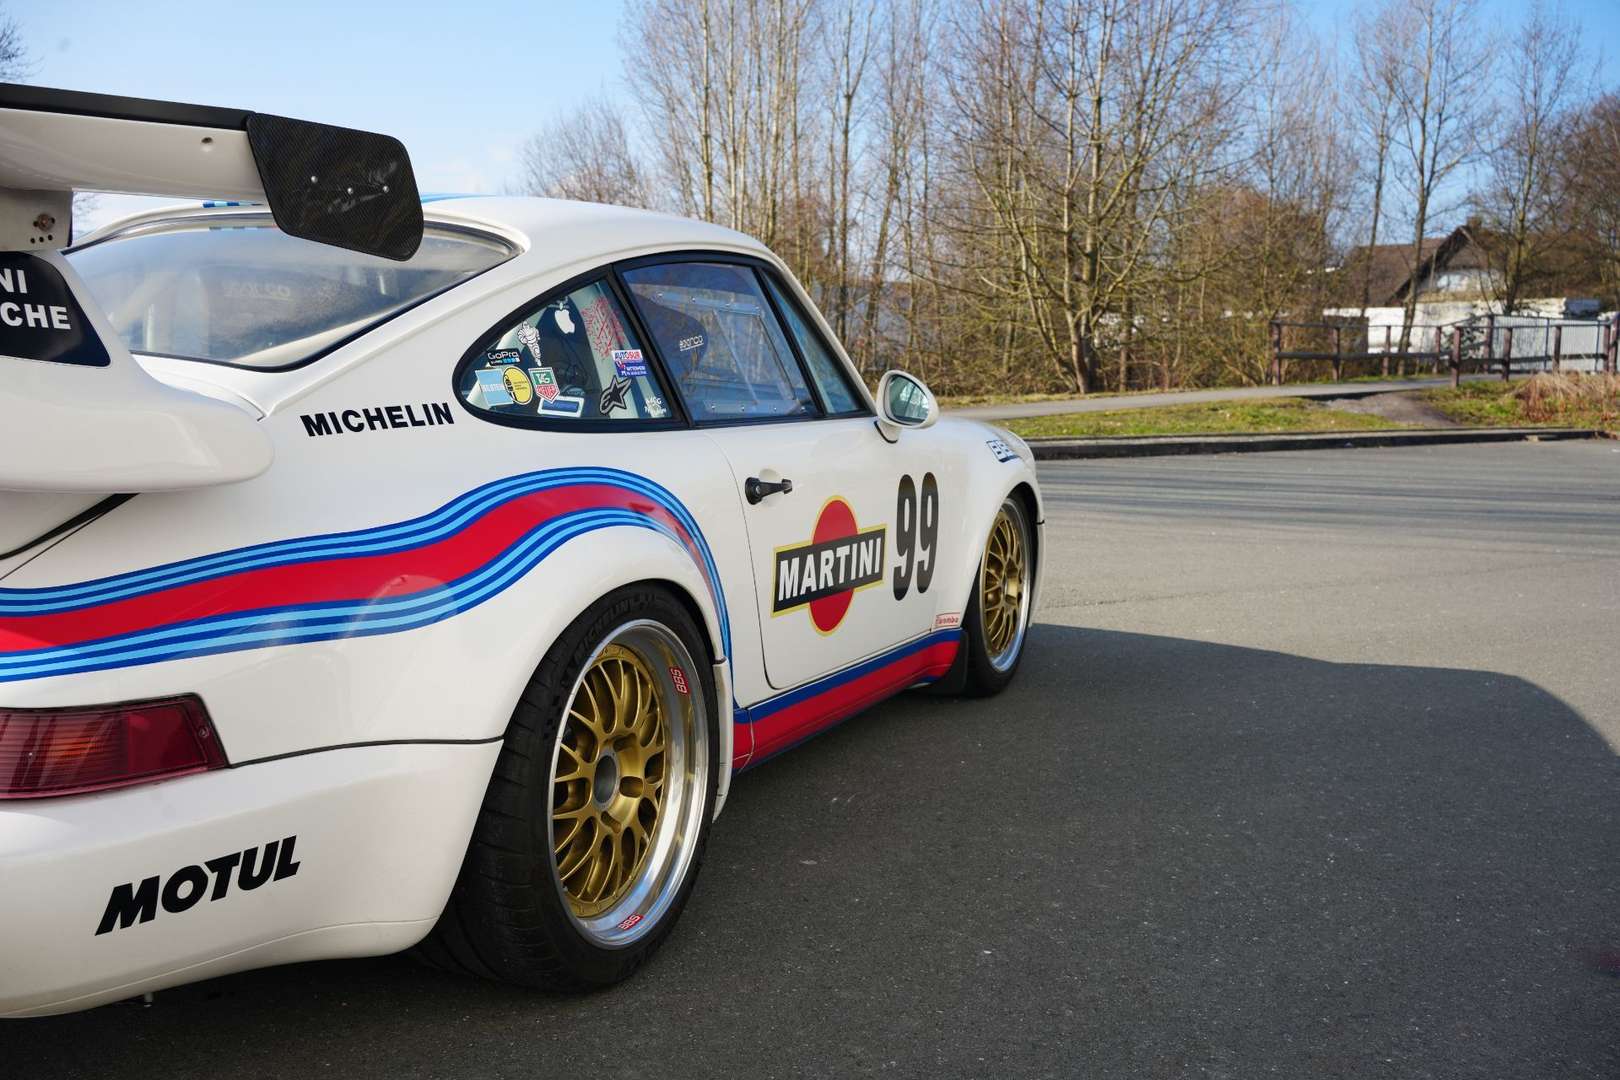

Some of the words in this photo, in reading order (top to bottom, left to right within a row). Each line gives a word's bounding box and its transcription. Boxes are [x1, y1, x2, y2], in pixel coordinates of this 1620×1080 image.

[0, 302, 71, 330] CHE
[487, 351, 519, 360] GoPro
[300, 402, 455, 437] MICHELIN
[892, 471, 939, 601] 99
[778, 537, 882, 601] MARTINI
[670, 667, 688, 695] BBS
[94, 835, 301, 936] MOTUL
[618, 914, 641, 930] BBS
